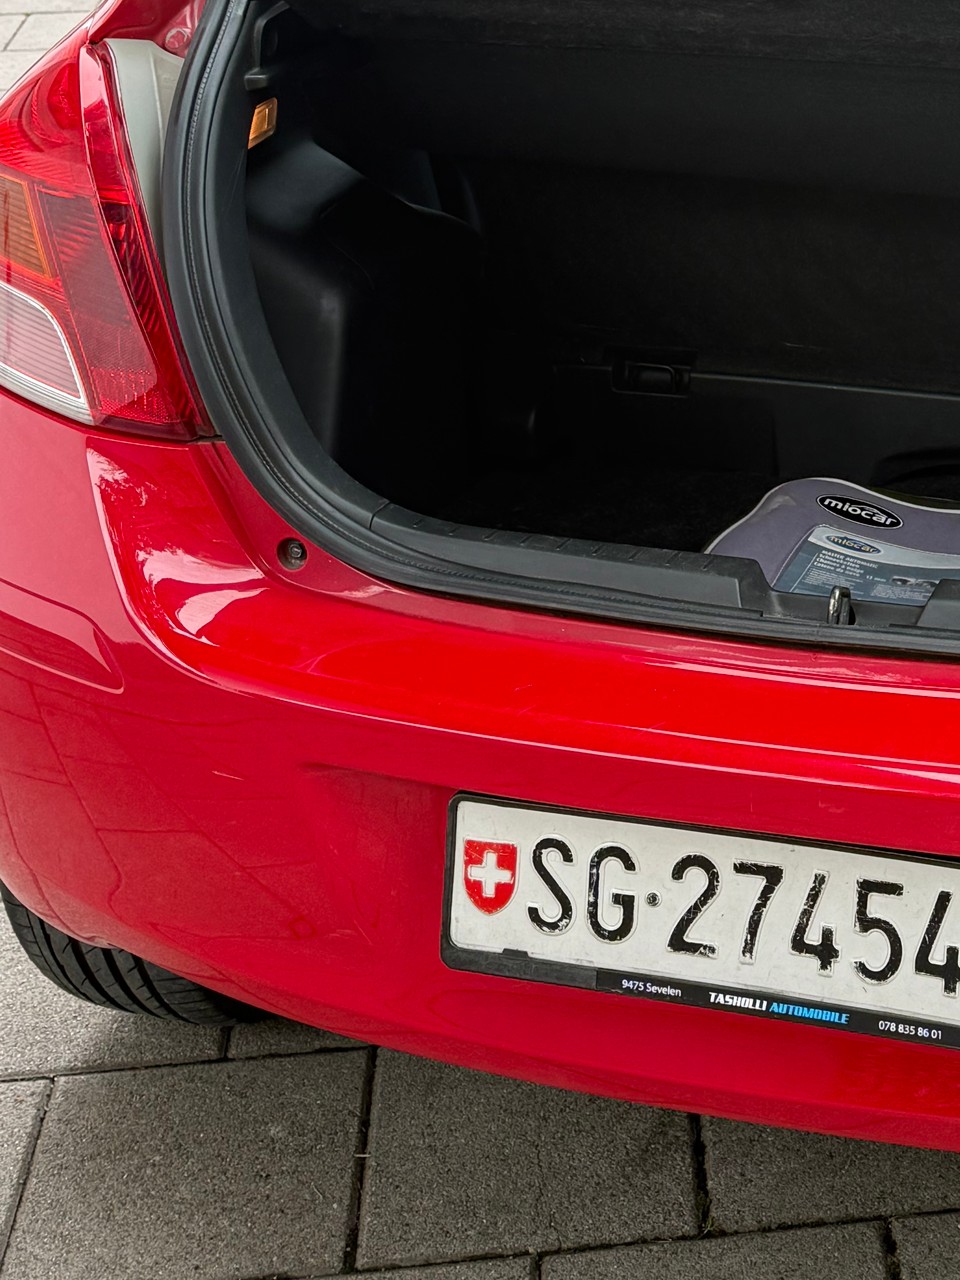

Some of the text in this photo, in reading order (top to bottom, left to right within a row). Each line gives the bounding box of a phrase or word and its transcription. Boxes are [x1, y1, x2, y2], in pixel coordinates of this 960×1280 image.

[823, 498, 898, 525] miocar
[830, 535, 878, 554] miocar
[621, 978, 682, 997] 9475 Sevelen
[709, 991, 850, 1025] TASHOLLI AUTOMOBILE
[878, 1020, 943, 1040] 078 835 86 01
